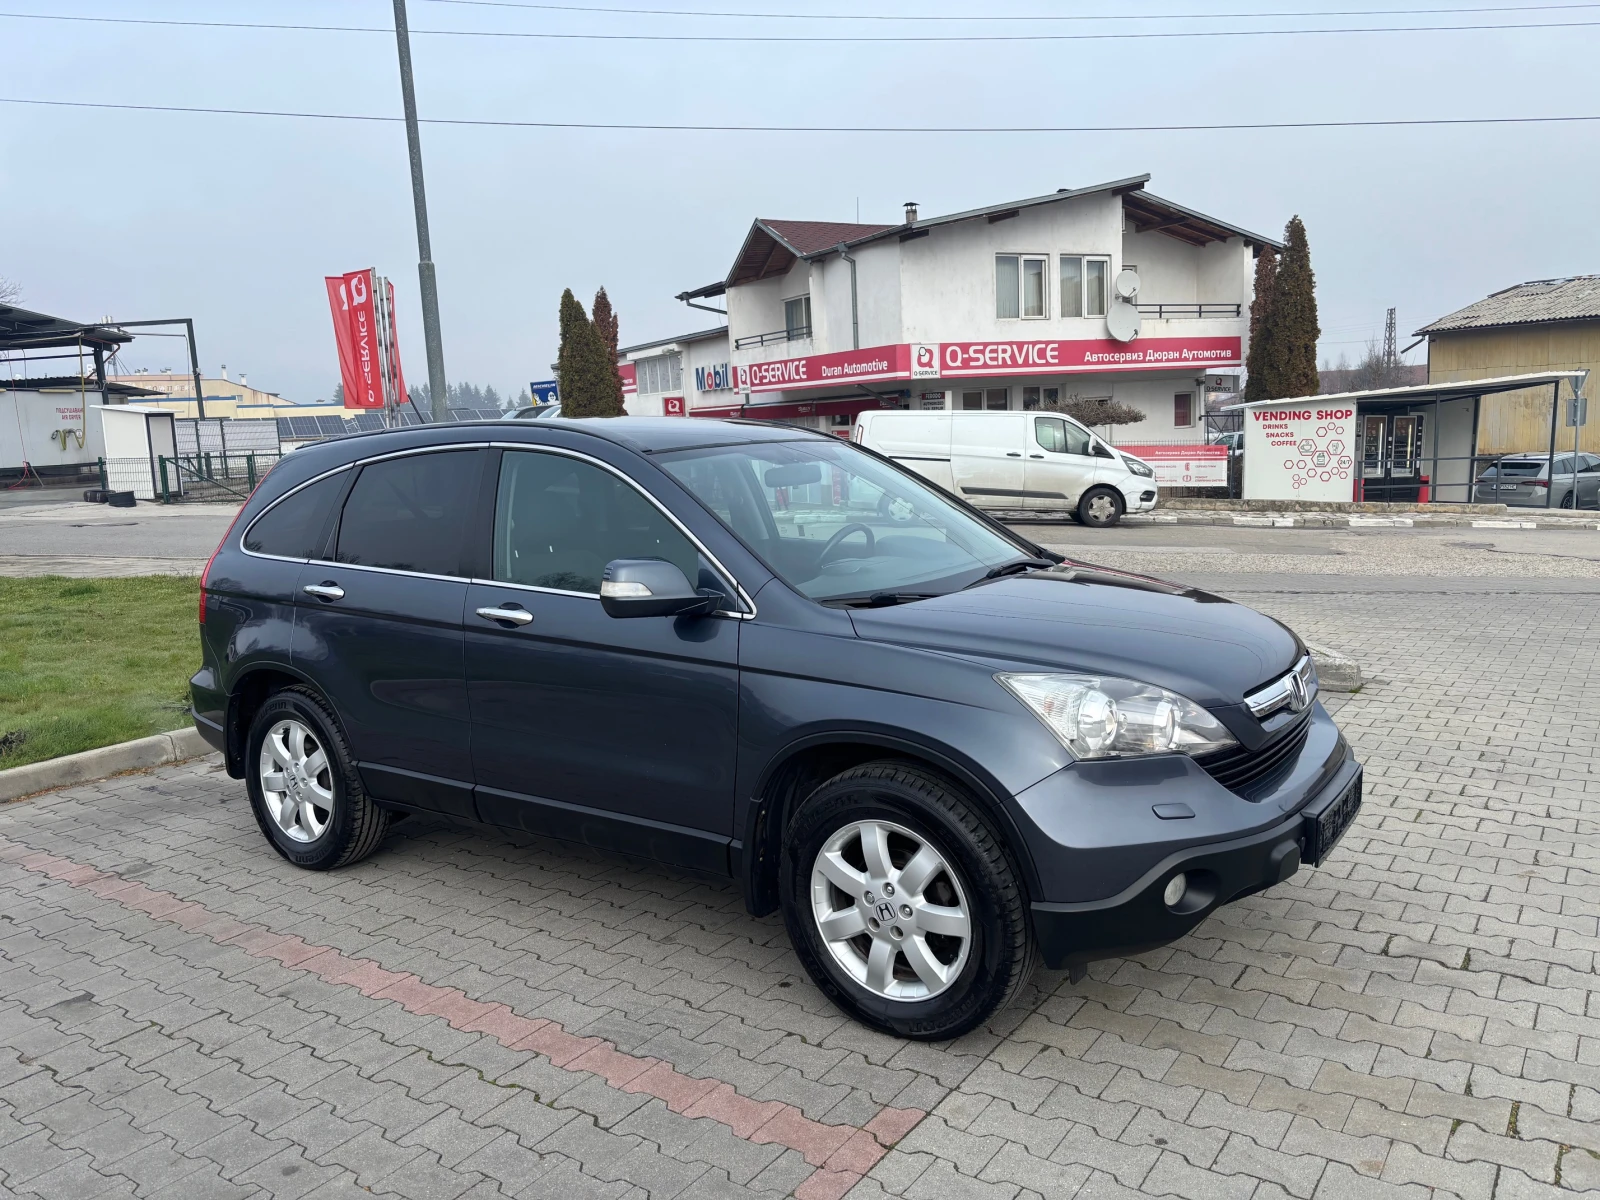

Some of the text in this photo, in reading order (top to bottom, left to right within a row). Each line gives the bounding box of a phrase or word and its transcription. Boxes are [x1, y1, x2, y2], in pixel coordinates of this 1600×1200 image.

[945, 343, 1059, 367] Q-SERVICE
[1084, 348, 1232, 364] Автосервиз Дюран Аутомотив
[695, 363, 729, 391] Mobil
[751, 360, 807, 384] Q-SERVICE
[821, 359, 888, 377] Duran Automotive
[1253, 409, 1353, 421] VENDING SHOP
